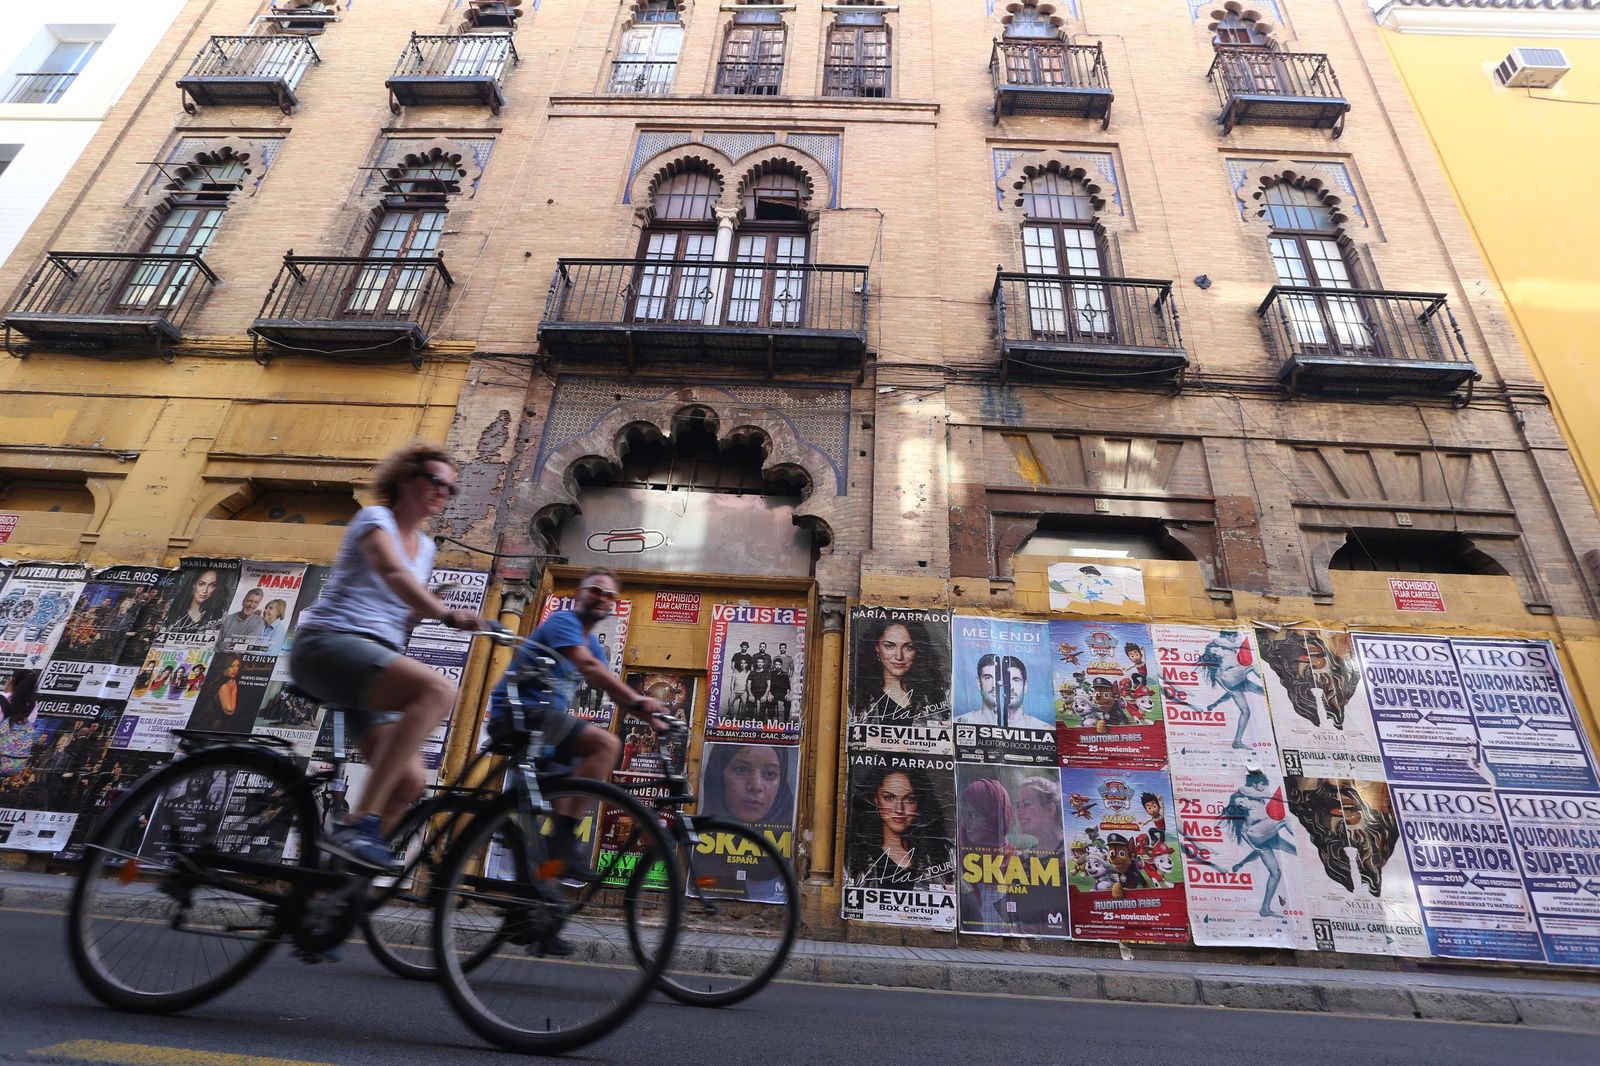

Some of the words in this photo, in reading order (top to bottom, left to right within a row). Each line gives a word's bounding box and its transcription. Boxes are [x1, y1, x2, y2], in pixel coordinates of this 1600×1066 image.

[15, 567, 57, 579] JOYERIA
[133, 572, 159, 583] RIOS
[257, 572, 303, 589] MAMÁ
[1391, 580, 1437, 591] PROHIBIDO
[656, 592, 700, 603] PROHIBIDO
[1411, 591, 1440, 600] CARTELES
[671, 603, 699, 611] CARTELES
[712, 604, 796, 625] Vetusta
[891, 611, 950, 622] PARRADO
[155, 633, 168, 642] 4
[168, 633, 216, 643] SEVILLA
[962, 627, 1040, 642] MELENDI
[1158, 647, 1180, 661] 25
[1184, 649, 1219, 662] años
[1360, 643, 1450, 662] KIROS
[1455, 648, 1547, 668] KIROS
[50, 662, 94, 675] SEVILLA
[1162, 666, 1198, 681] Mes
[42, 673, 58, 689] 24
[1366, 667, 1460, 687] QUIROMASAJE
[1462, 672, 1559, 693] QUIROMASAJE
[1164, 686, 1187, 700] De
[1373, 687, 1465, 710] SUPERIOR
[35, 700, 71, 713] MIGUEL
[72, 704, 101, 716] RIOS
[924, 701, 947, 714] TOUR
[1472, 693, 1565, 716] SUPERIOR
[577, 707, 612, 720] Morla
[1166, 706, 1226, 722] Danza
[123, 721, 131, 733] 3
[718, 716, 764, 729] Vetusta
[766, 720, 800, 731] Morla
[266, 729, 315, 740] NOVIEMBRE
[868, 725, 950, 742] SEVILLA
[957, 730, 974, 739] 27
[979, 727, 1056, 744] SEVILLA
[903, 738, 937, 747] Cartuja
[978, 739, 1010, 748] AUDITORIO
[1088, 744, 1099, 752] 25
[1104, 745, 1140, 754] noviembre
[892, 757, 954, 770] PARRADO
[1286, 754, 1300, 768] 31
[1300, 751, 1326, 760] SEVILLA
[1357, 755, 1382, 763] CENTER
[1178, 798, 1203, 814] 25
[1206, 801, 1246, 815] años
[1398, 792, 1497, 815] KIROS
[1504, 799, 1600, 820] KIROS
[1182, 820, 1223, 837] Mes
[1405, 820, 1509, 844] QUIROMASAJE
[696, 830, 792, 858] SKAM
[1185, 844, 1211, 859] De
[727, 855, 758, 865] ESPAÑA
[1413, 844, 1515, 871] SUPERIOR
[926, 862, 952, 876] TOUR
[962, 853, 1061, 887] SKAM
[1188, 867, 1253, 884] Danza
[1445, 874, 1464, 882] 2018
[1557, 881, 1577, 889] 2018
[997, 883, 1028, 894] ESPAÑA
[847, 890, 859, 907] 4
[865, 890, 955, 908] SEVILLA
[1094, 900, 1137, 910] AUDITORIO
[879, 904, 900, 912] BOX
[903, 906, 940, 915] Cartuja
[1103, 911, 1114, 920] 25
[1120, 912, 1159, 921] noviembre
[1315, 925, 1331, 940] 31
[1332, 921, 1360, 932] SEVILLA
[1396, 925, 1424, 936] CENTER
